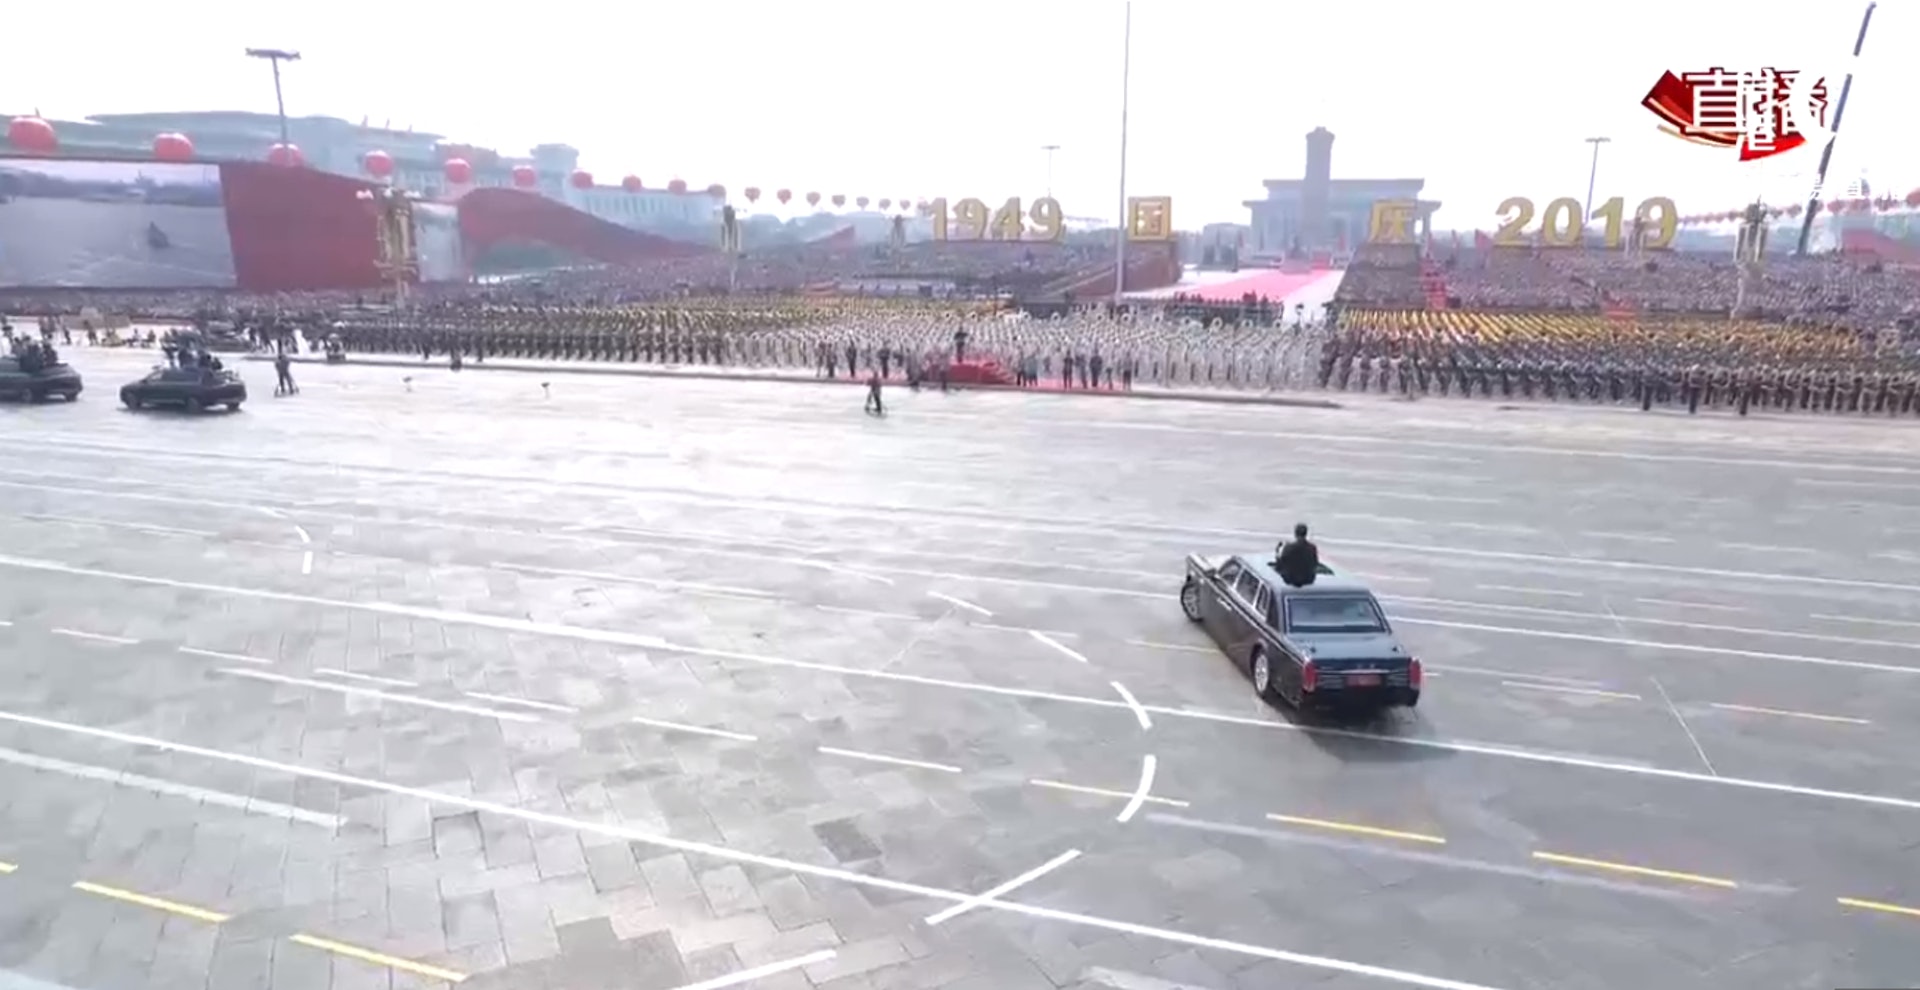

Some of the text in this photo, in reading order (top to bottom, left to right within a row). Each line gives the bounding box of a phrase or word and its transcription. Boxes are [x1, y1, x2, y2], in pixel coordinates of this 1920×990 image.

[927, 197, 1065, 242] 1949
[1128, 197, 1172, 242] 国
[1368, 200, 1414, 245] 庆
[1495, 196, 1679, 247] 2019
